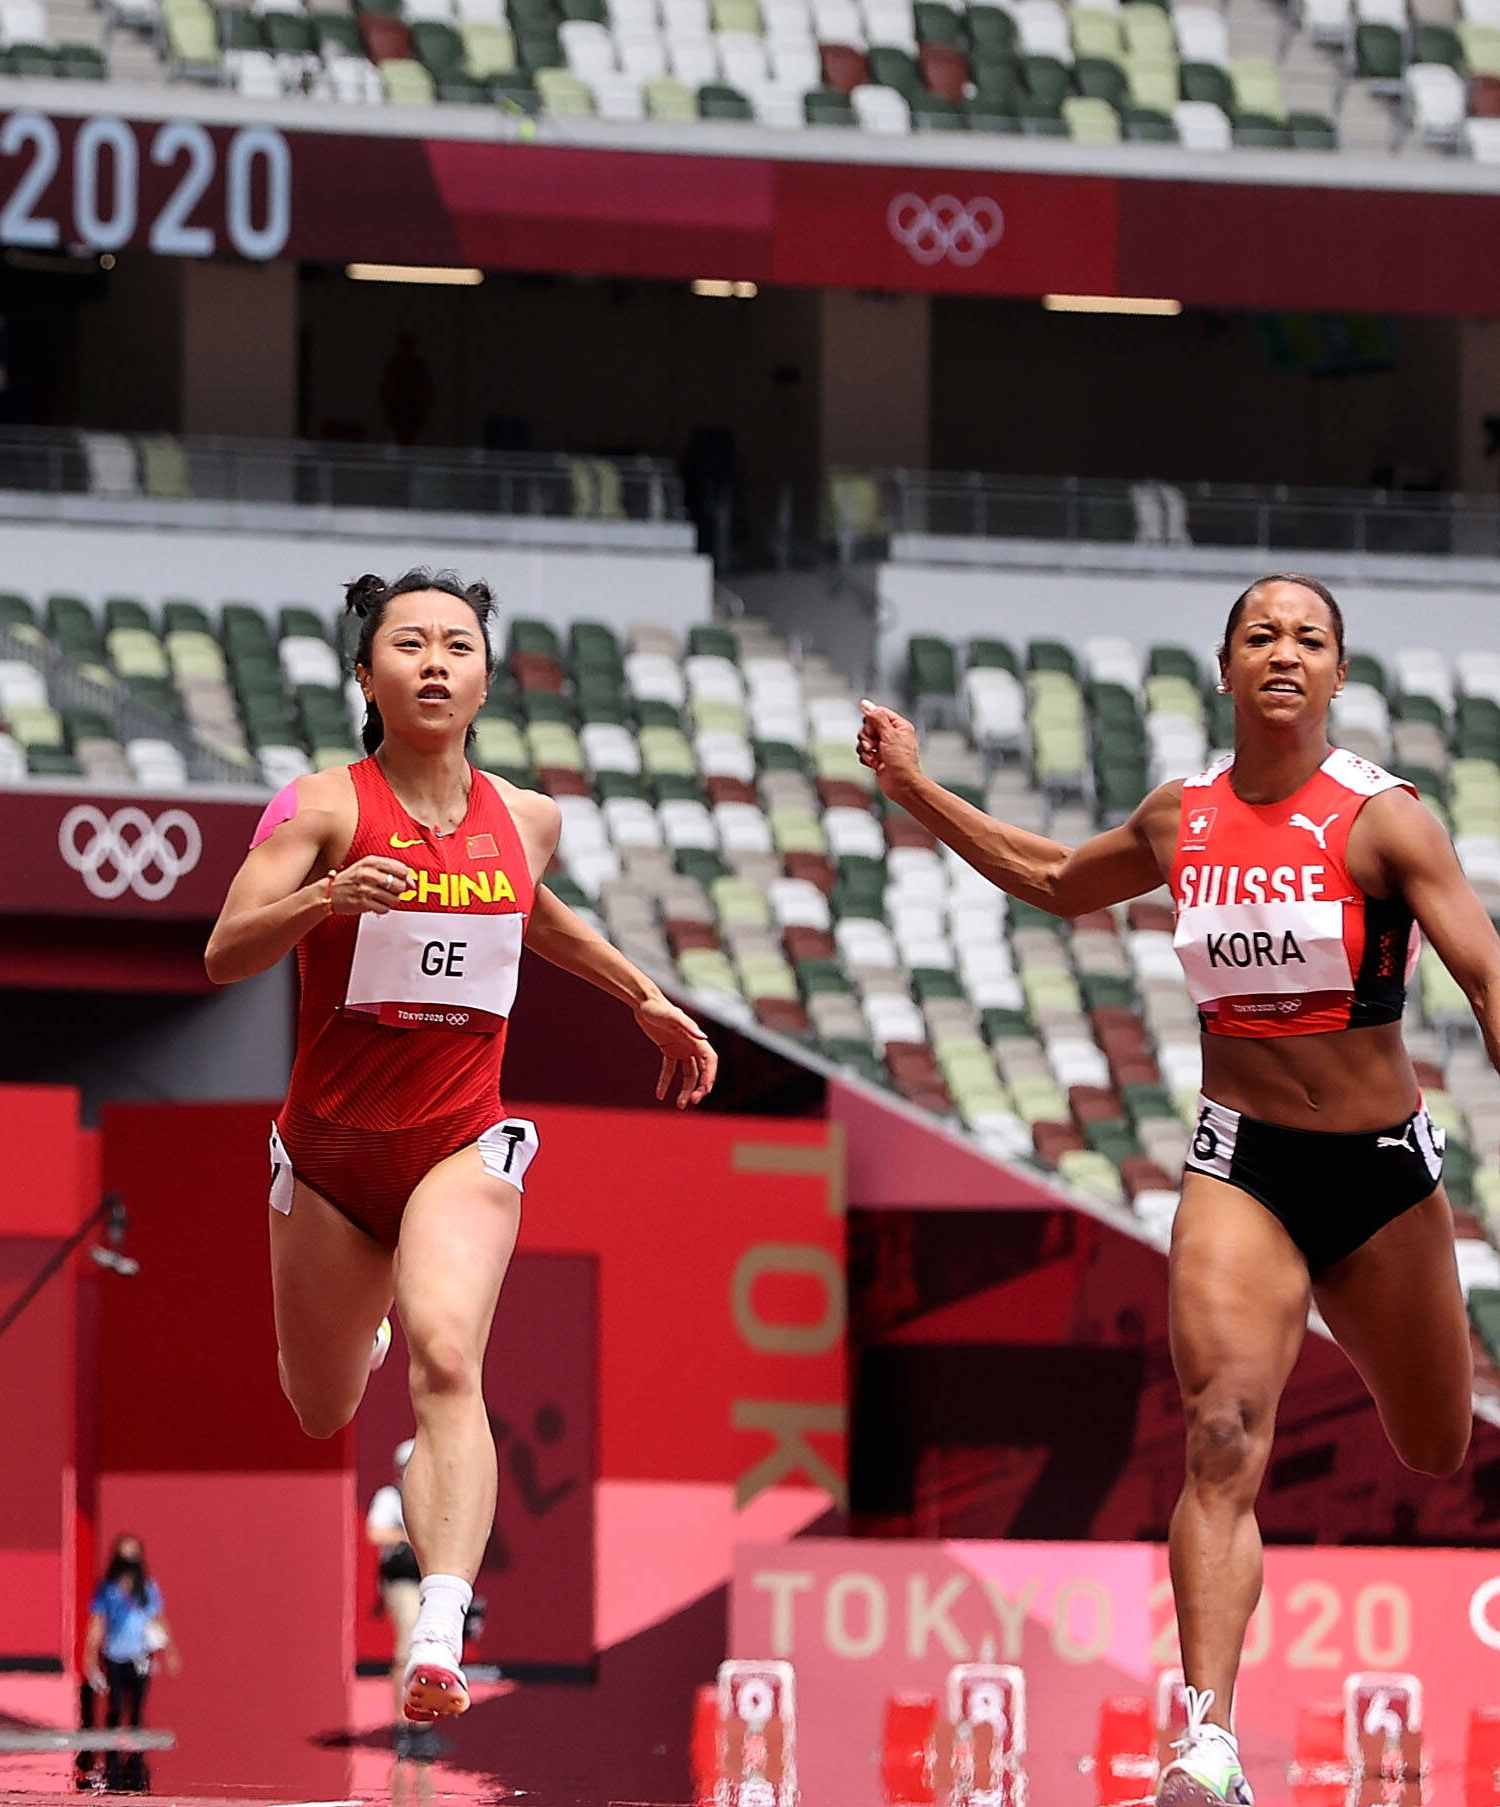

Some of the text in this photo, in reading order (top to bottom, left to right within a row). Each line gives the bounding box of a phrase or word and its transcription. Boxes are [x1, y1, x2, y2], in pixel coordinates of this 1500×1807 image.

[1179, 865, 1326, 907] SUISSE
[421, 941, 467, 977] GE
[1206, 930, 1306, 968] KORA
[398, 1010, 444, 1022] TOKYO 2020
[501, 1126, 526, 1173] 7
[753, 1570, 1112, 1661] TOKYO
